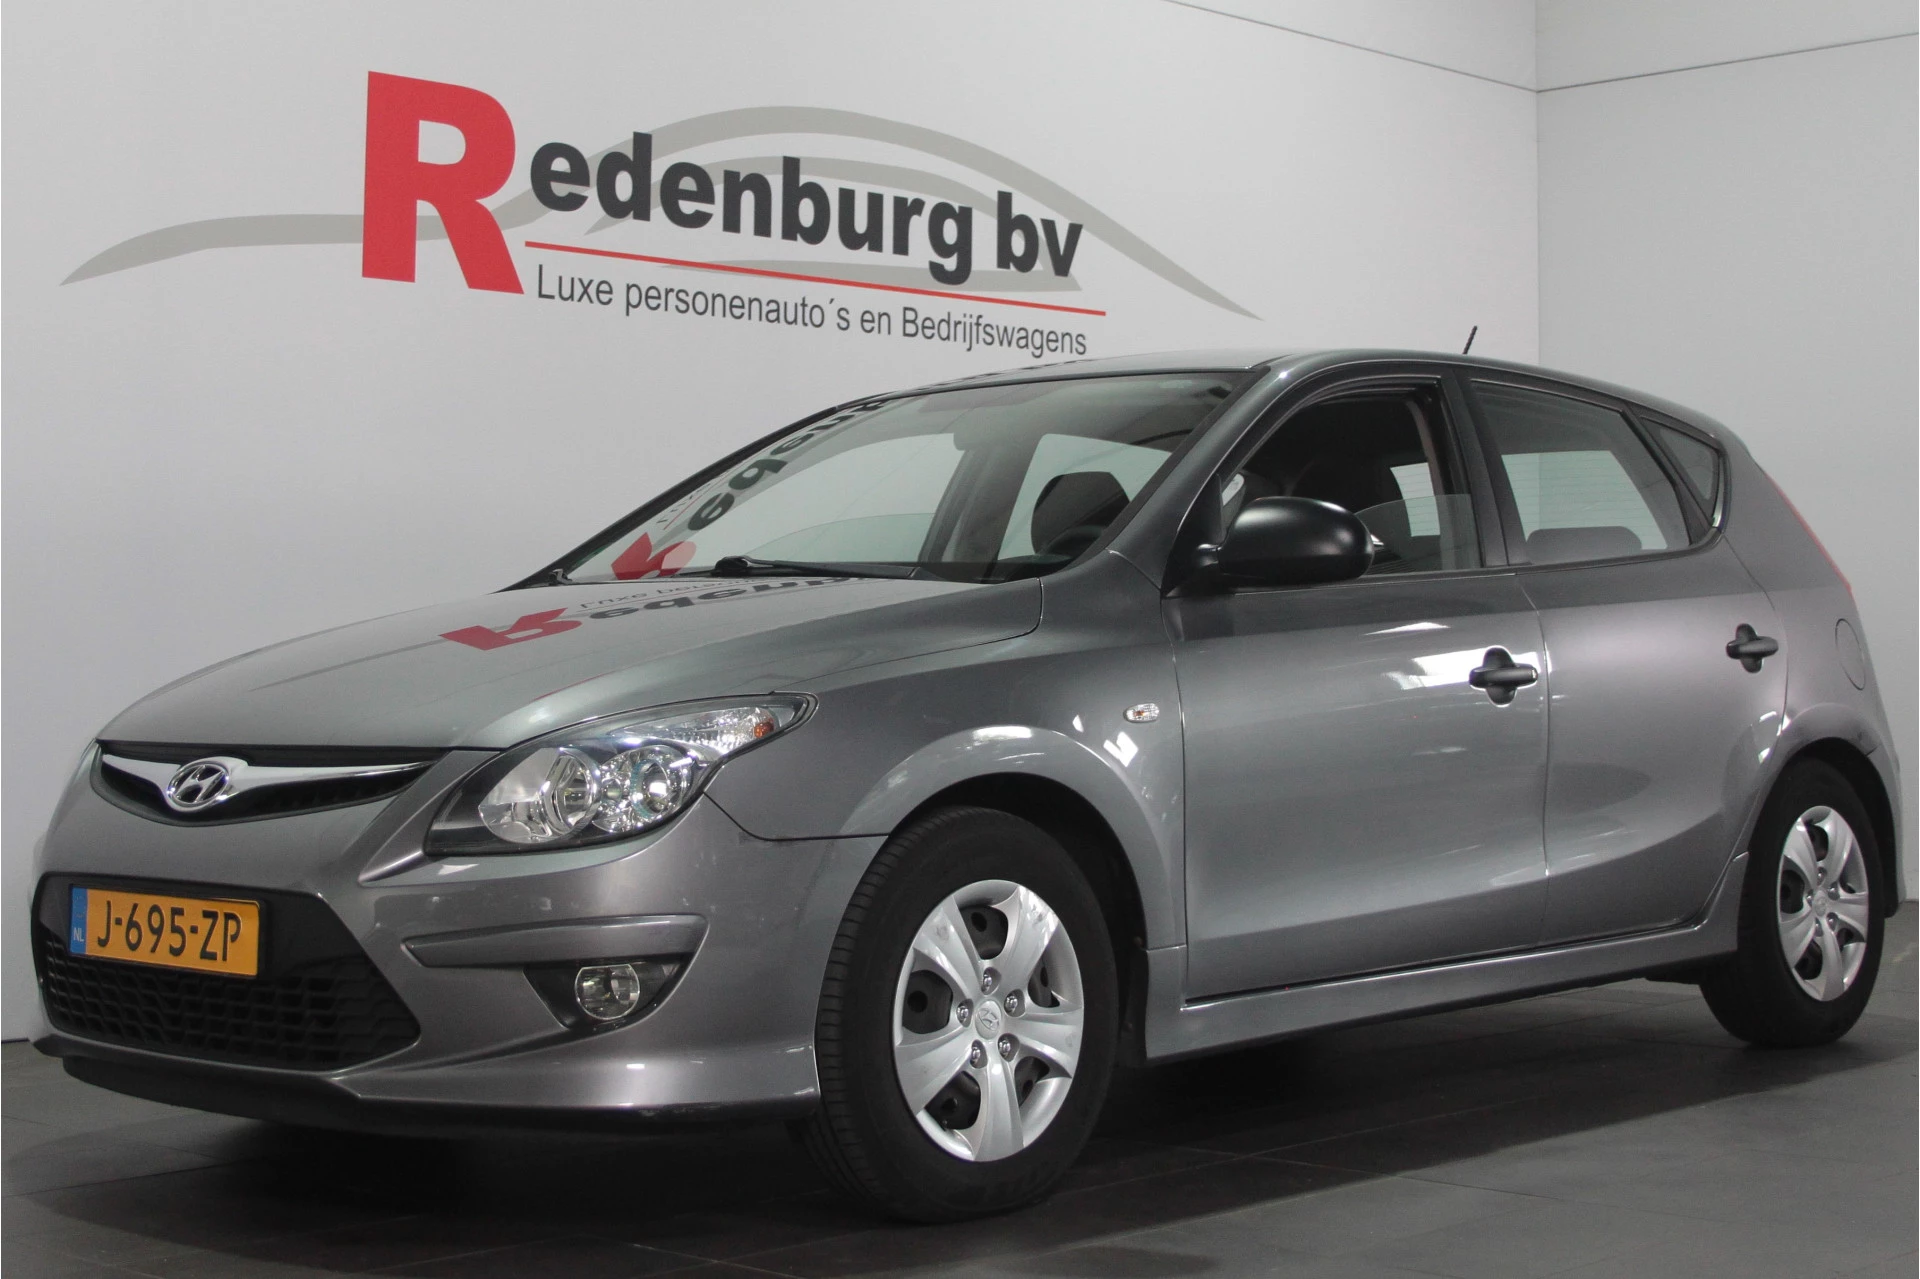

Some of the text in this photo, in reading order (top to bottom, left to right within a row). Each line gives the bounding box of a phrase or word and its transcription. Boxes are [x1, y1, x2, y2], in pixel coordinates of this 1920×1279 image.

[362, 71, 1084, 294] Redenburg bv
[537, 264, 614, 305] Luxe
[860, 308, 892, 336] en
[903, 307, 1087, 358] Bedrijfswagens
[73, 927, 84, 942] NL
[98, 900, 242, 961] J-695-ZP
